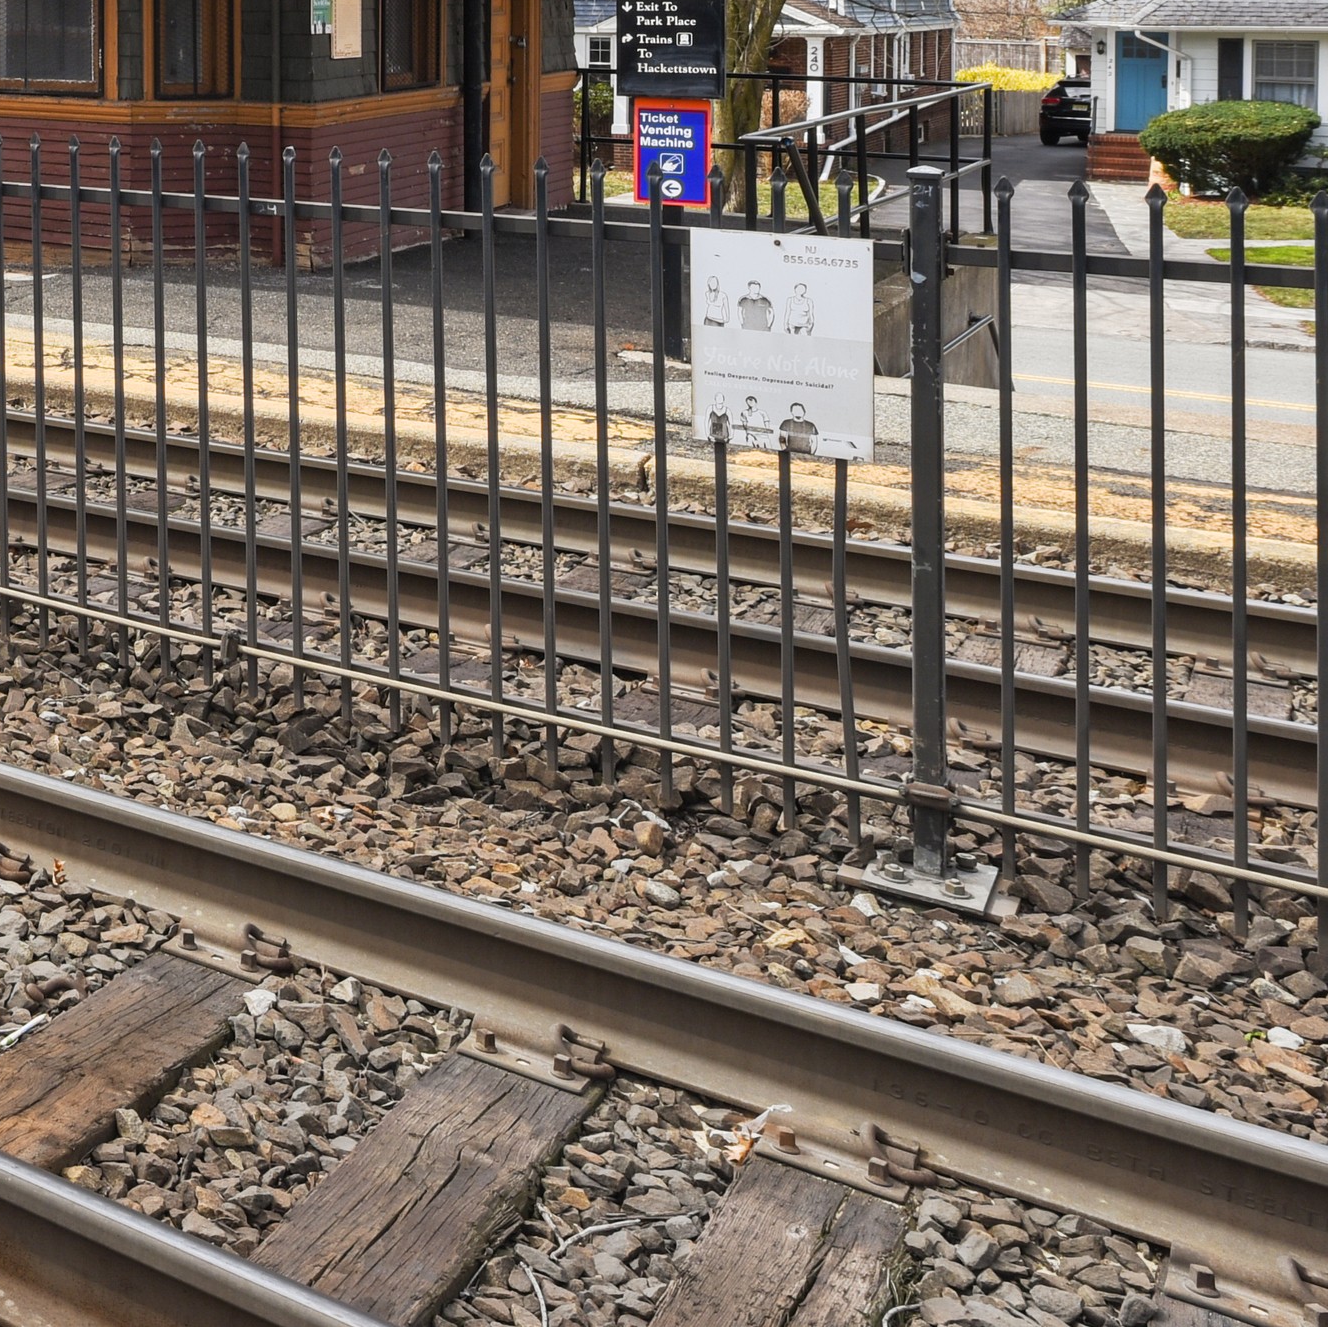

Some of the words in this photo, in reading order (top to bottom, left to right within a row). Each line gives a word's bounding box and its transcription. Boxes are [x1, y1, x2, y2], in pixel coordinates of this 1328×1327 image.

[636, 1, 659, 12] Exit
[662, 1, 678, 12] To
[636, 16, 663, 26] Park
[666, 16, 697, 26] Place
[636, 34, 673, 45] Trains
[636, 48, 653, 59] To
[810, 46, 819, 72] 240
[637, 63, 718, 75] Hackettstown
[639, 112, 679, 124] Ticket
[639, 124, 692, 138] Vending
[639, 136, 694, 149] Machine
[805, 245, 818, 254] NJ
[783, 254, 859, 269] 855.654.6735
[703, 346, 762, 371] You're
[767, 353, 801, 376] Not
[804, 356, 861, 381] Alone
[704, 370, 726, 379] Feeling
[761, 376, 795, 386] Depressed
[805, 381, 835, 390] Suicidal?
[1199, 1176, 1328, 1232] STEELT
